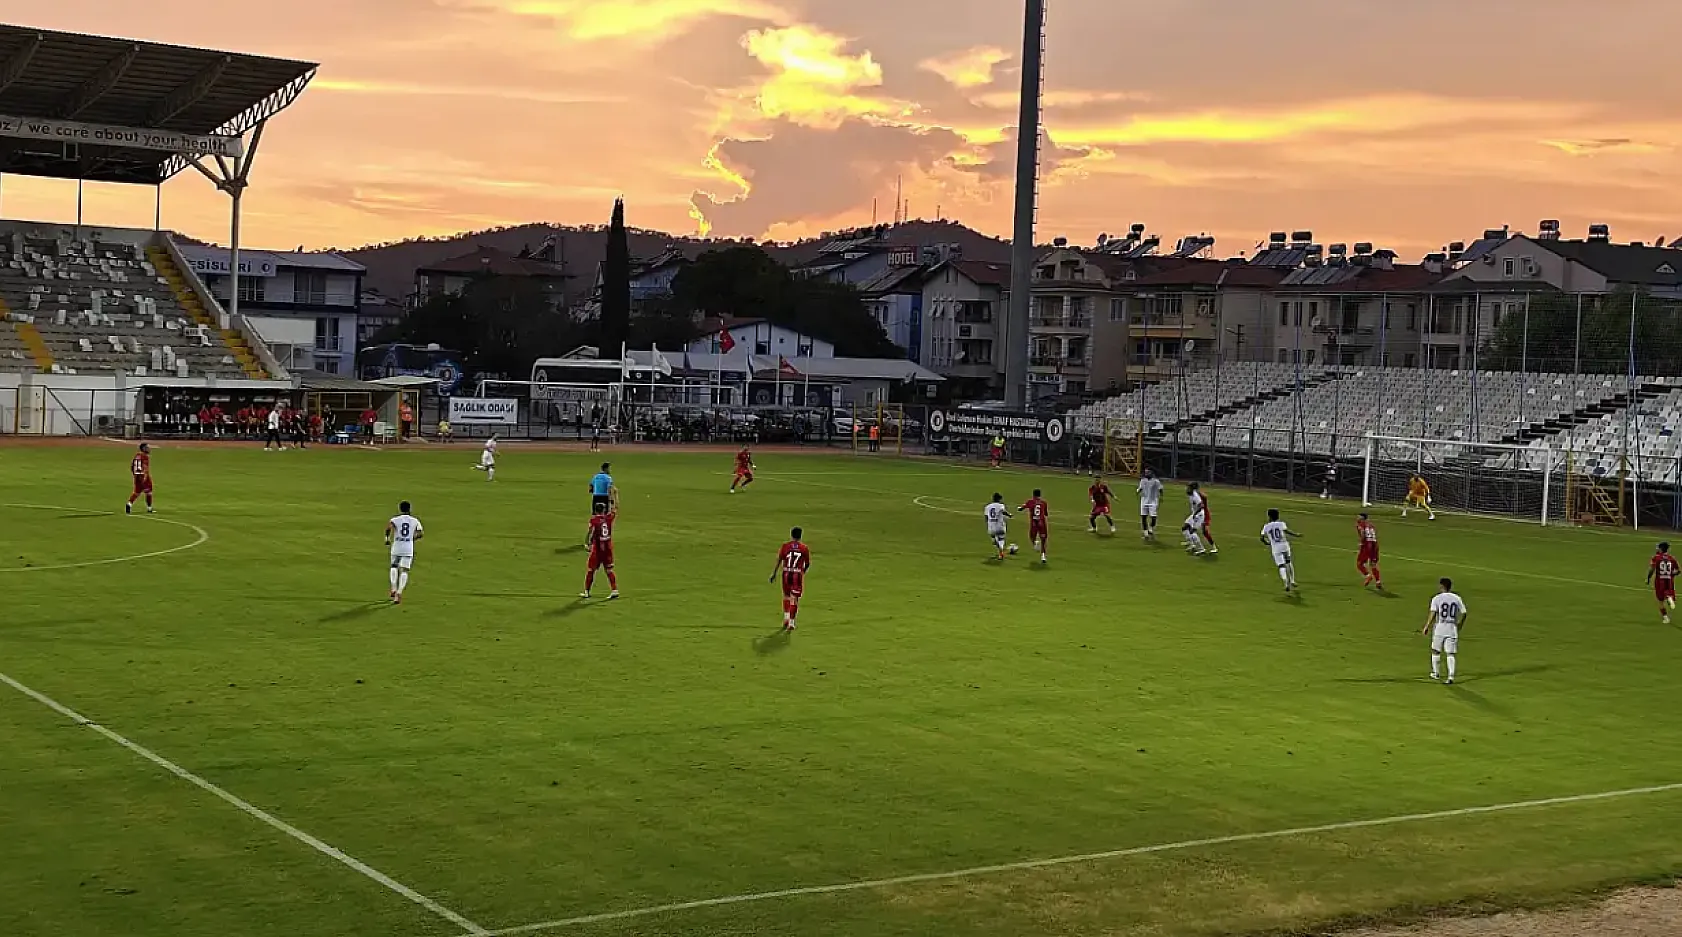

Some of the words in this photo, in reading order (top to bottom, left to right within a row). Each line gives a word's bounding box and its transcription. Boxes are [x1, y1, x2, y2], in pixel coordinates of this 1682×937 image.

[28, 124, 51, 135] we
[56, 127, 89, 139] care
[95, 129, 139, 143] about
[143, 133, 178, 146] your
[181, 136, 227, 150] health
[887, 252, 917, 265] HOTEL
[1034, 504, 1041, 517] 6
[401, 522, 410, 538] 8
[1269, 528, 1281, 540] 10
[786, 551, 802, 568] 17
[1659, 560, 1672, 575] 93
[1441, 602, 1457, 618] 80
